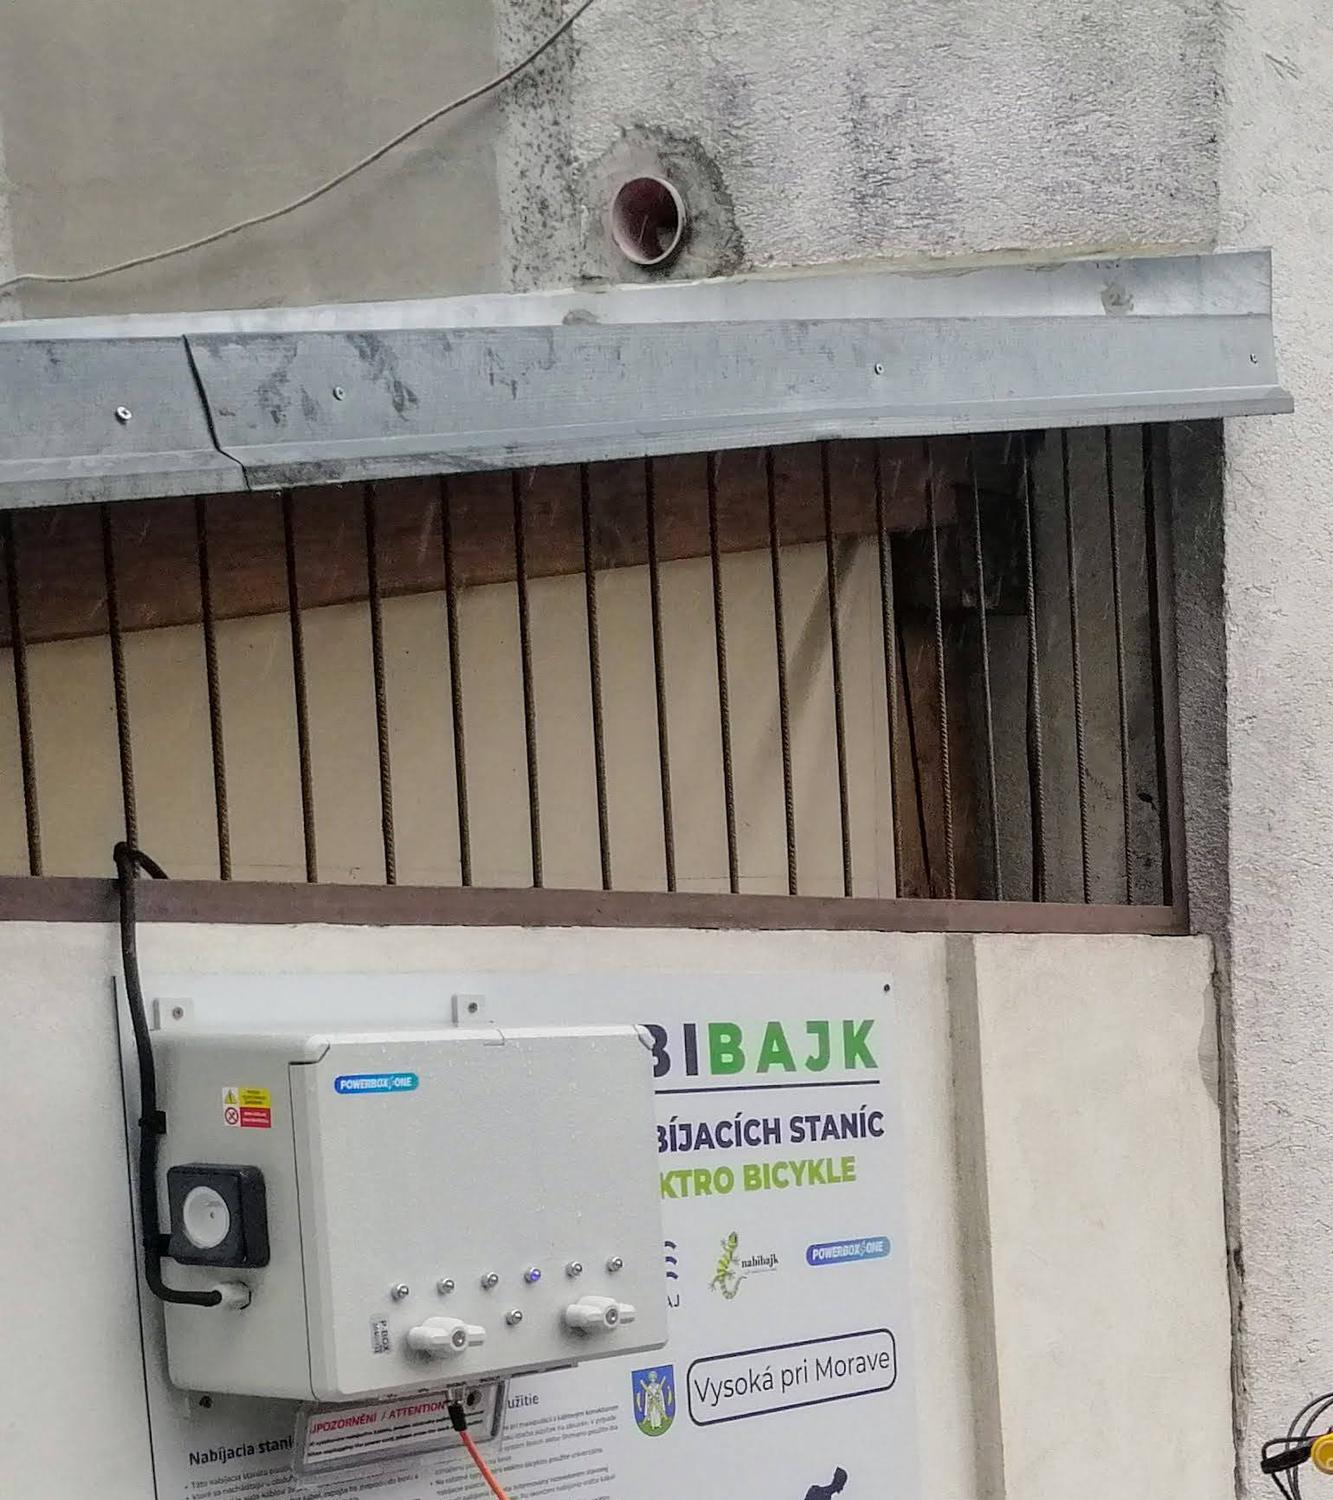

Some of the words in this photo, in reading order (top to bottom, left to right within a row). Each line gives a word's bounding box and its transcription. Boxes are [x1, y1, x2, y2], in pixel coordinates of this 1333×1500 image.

[790, 1105, 885, 1143] STANÍC
[743, 1156, 857, 1191] BICYKLE
[695, 1365, 774, 1407] Vysoká
[781, 1358, 808, 1393] pri
[816, 1351, 890, 1382] Morave
[389, 1401, 447, 1419] ATTENTION
[508, 1393, 539, 1409] užitie
[189, 1442, 254, 1466] Nabíjacia
